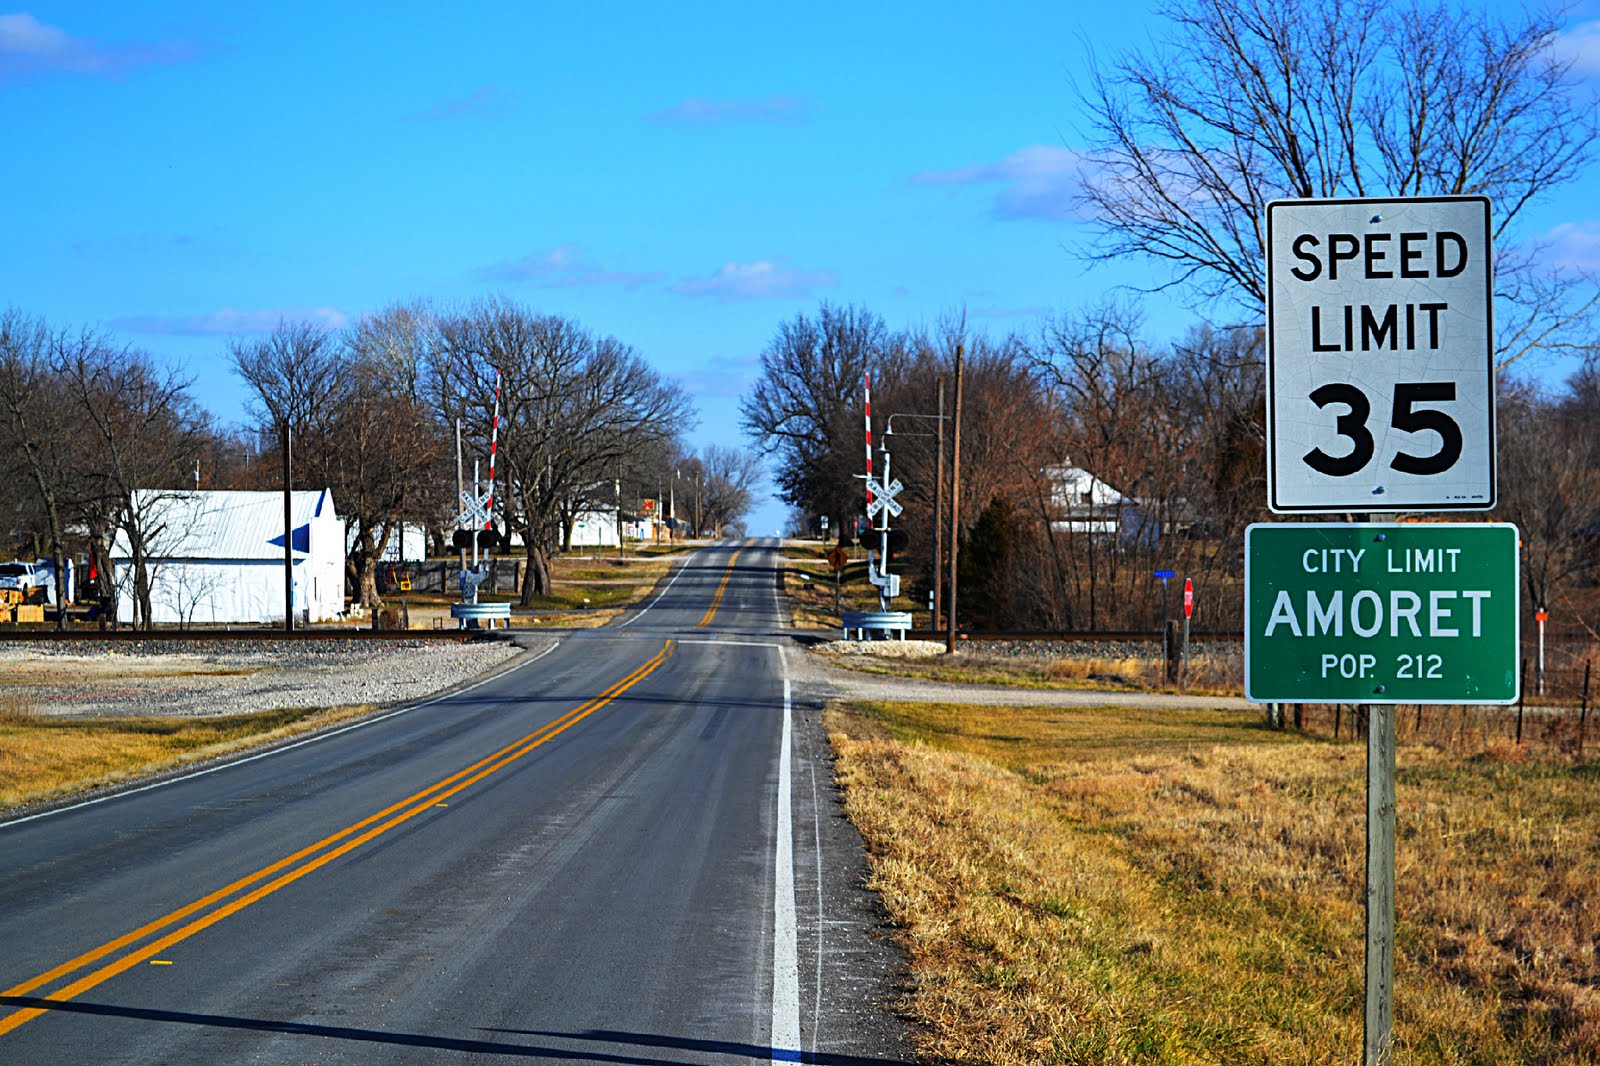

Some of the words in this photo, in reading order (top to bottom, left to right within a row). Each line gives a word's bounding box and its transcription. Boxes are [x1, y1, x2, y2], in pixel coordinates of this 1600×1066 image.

[1291, 231, 1468, 282] SPEED
[1312, 303, 1448, 352] LIMIT
[1303, 382, 1463, 477] 35
[1302, 549, 1366, 573] CITY
[1387, 549, 1461, 573] LIMIT
[1264, 590, 1492, 638] AMORET
[1321, 654, 1377, 679] POP.
[1396, 654, 1443, 679] 212
